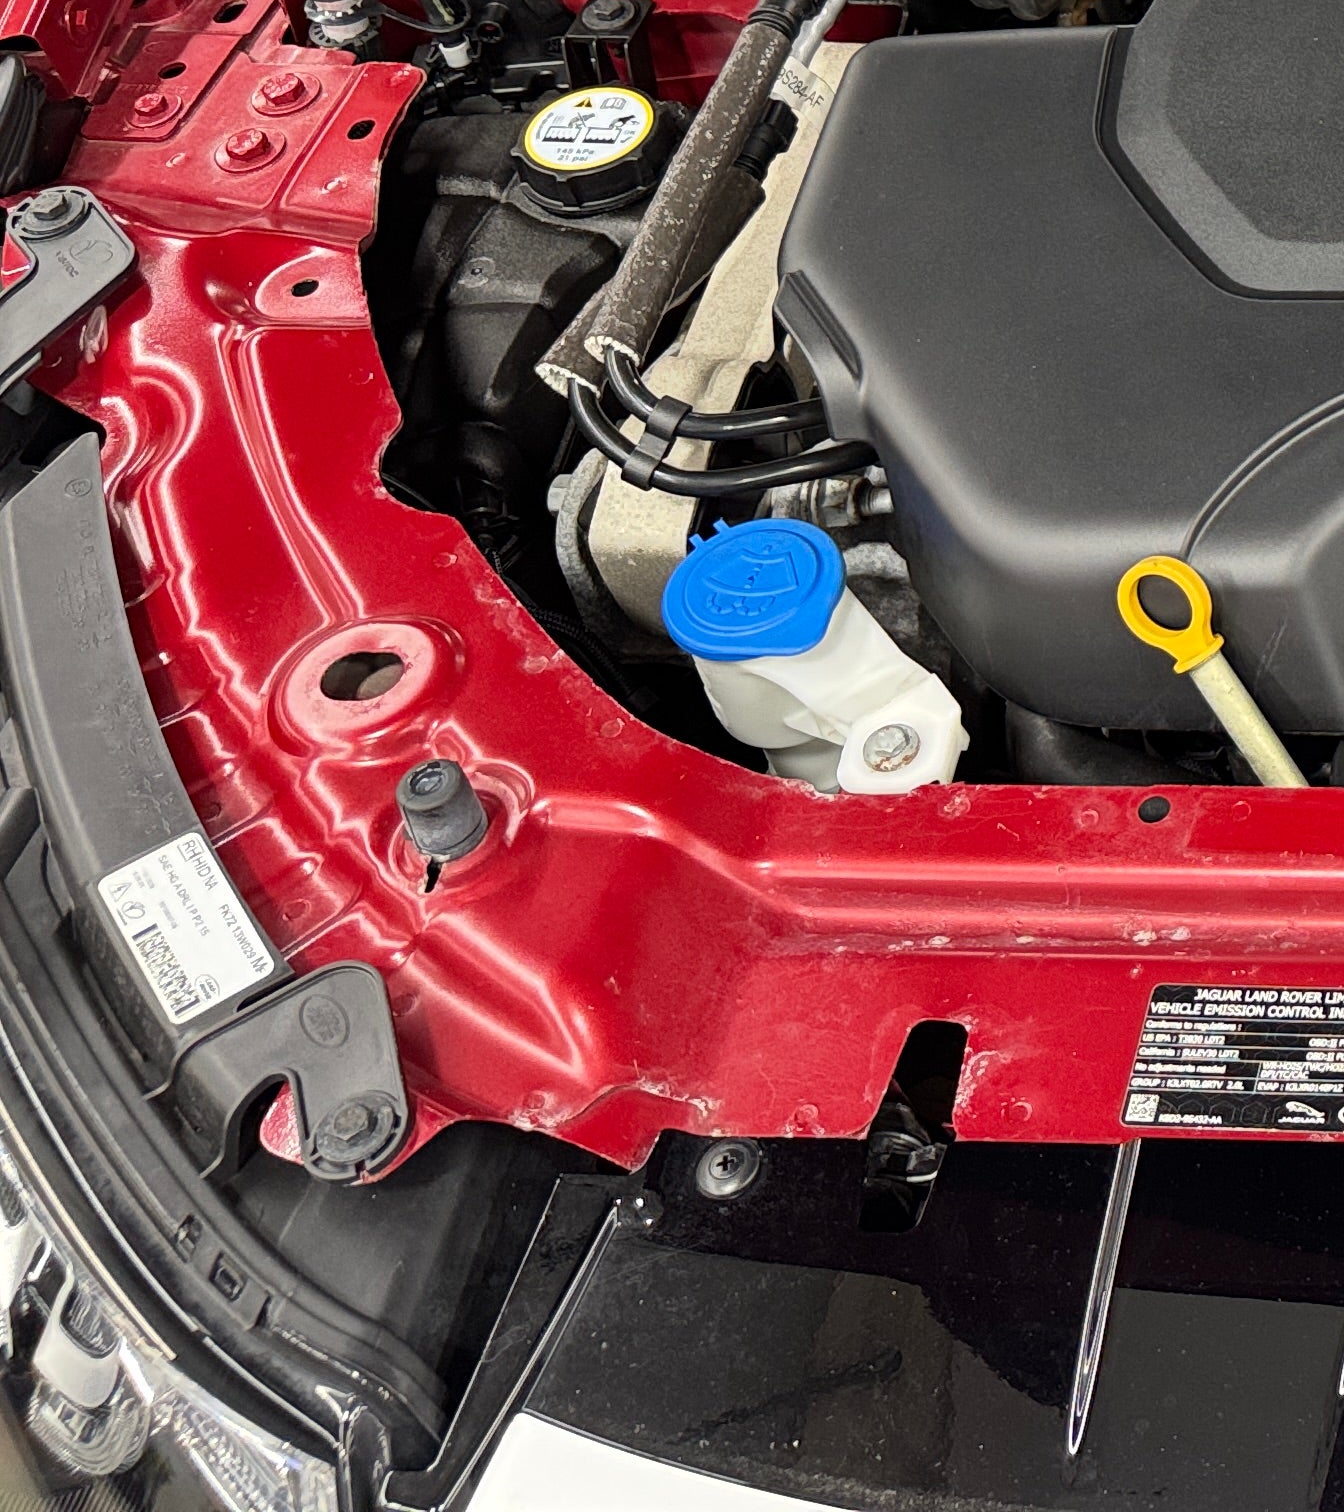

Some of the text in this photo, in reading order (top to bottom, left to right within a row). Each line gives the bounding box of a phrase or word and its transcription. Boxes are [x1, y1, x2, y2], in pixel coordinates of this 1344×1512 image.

[157, 854, 172, 872] SAE
[181, 838, 200, 859] RH
[191, 855, 212, 878] HID
[1194, 988, 1242, 1001] JAGUAR
[1244, 990, 1279, 1002] LAND
[1280, 991, 1322, 1004] ROVER
[1150, 1002, 1202, 1016] VEHICLE
[1204, 1003, 1265, 1017] EMISSION
[1267, 1005, 1326, 1019] CONTROL
[1130, 1078, 1161, 1087] GROUP
[1278, 1116, 1325, 1124] JAGUAR
